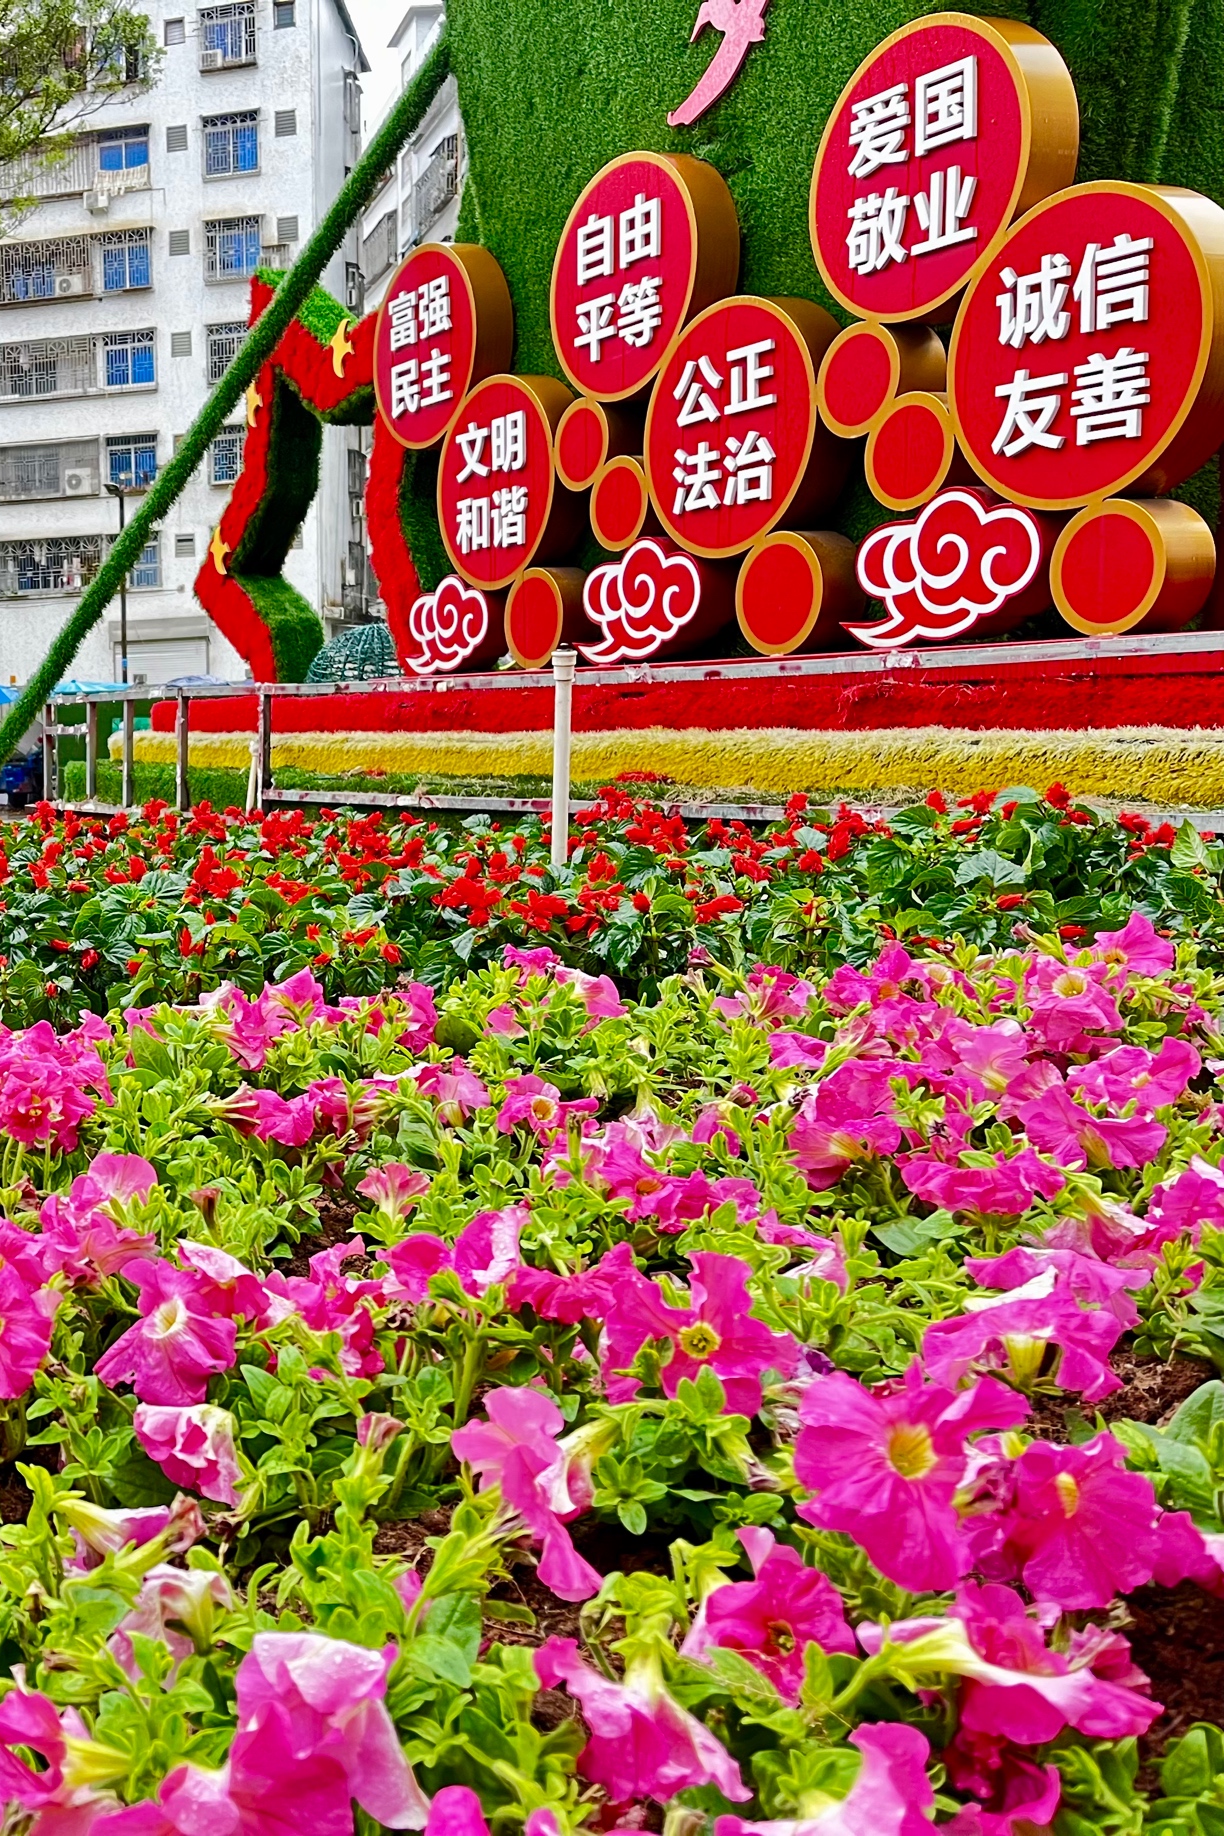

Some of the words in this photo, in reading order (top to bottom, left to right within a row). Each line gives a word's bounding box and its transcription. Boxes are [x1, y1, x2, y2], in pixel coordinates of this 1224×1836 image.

[847, 54, 978, 179] 爱国
[576, 192, 662, 286] 自由
[845, 165, 978, 276] 敬业
[387, 274, 453, 352] 富强
[573, 275, 663, 363] 平等
[994, 232, 1154, 349] 诚信
[389, 347, 454, 420] 民主
[672, 337, 778, 428] 公正
[990, 346, 1151, 458] 友善
[455, 409, 527, 484] 文明
[672, 430, 777, 515] 法治
[455, 485, 529, 555] 和谐
